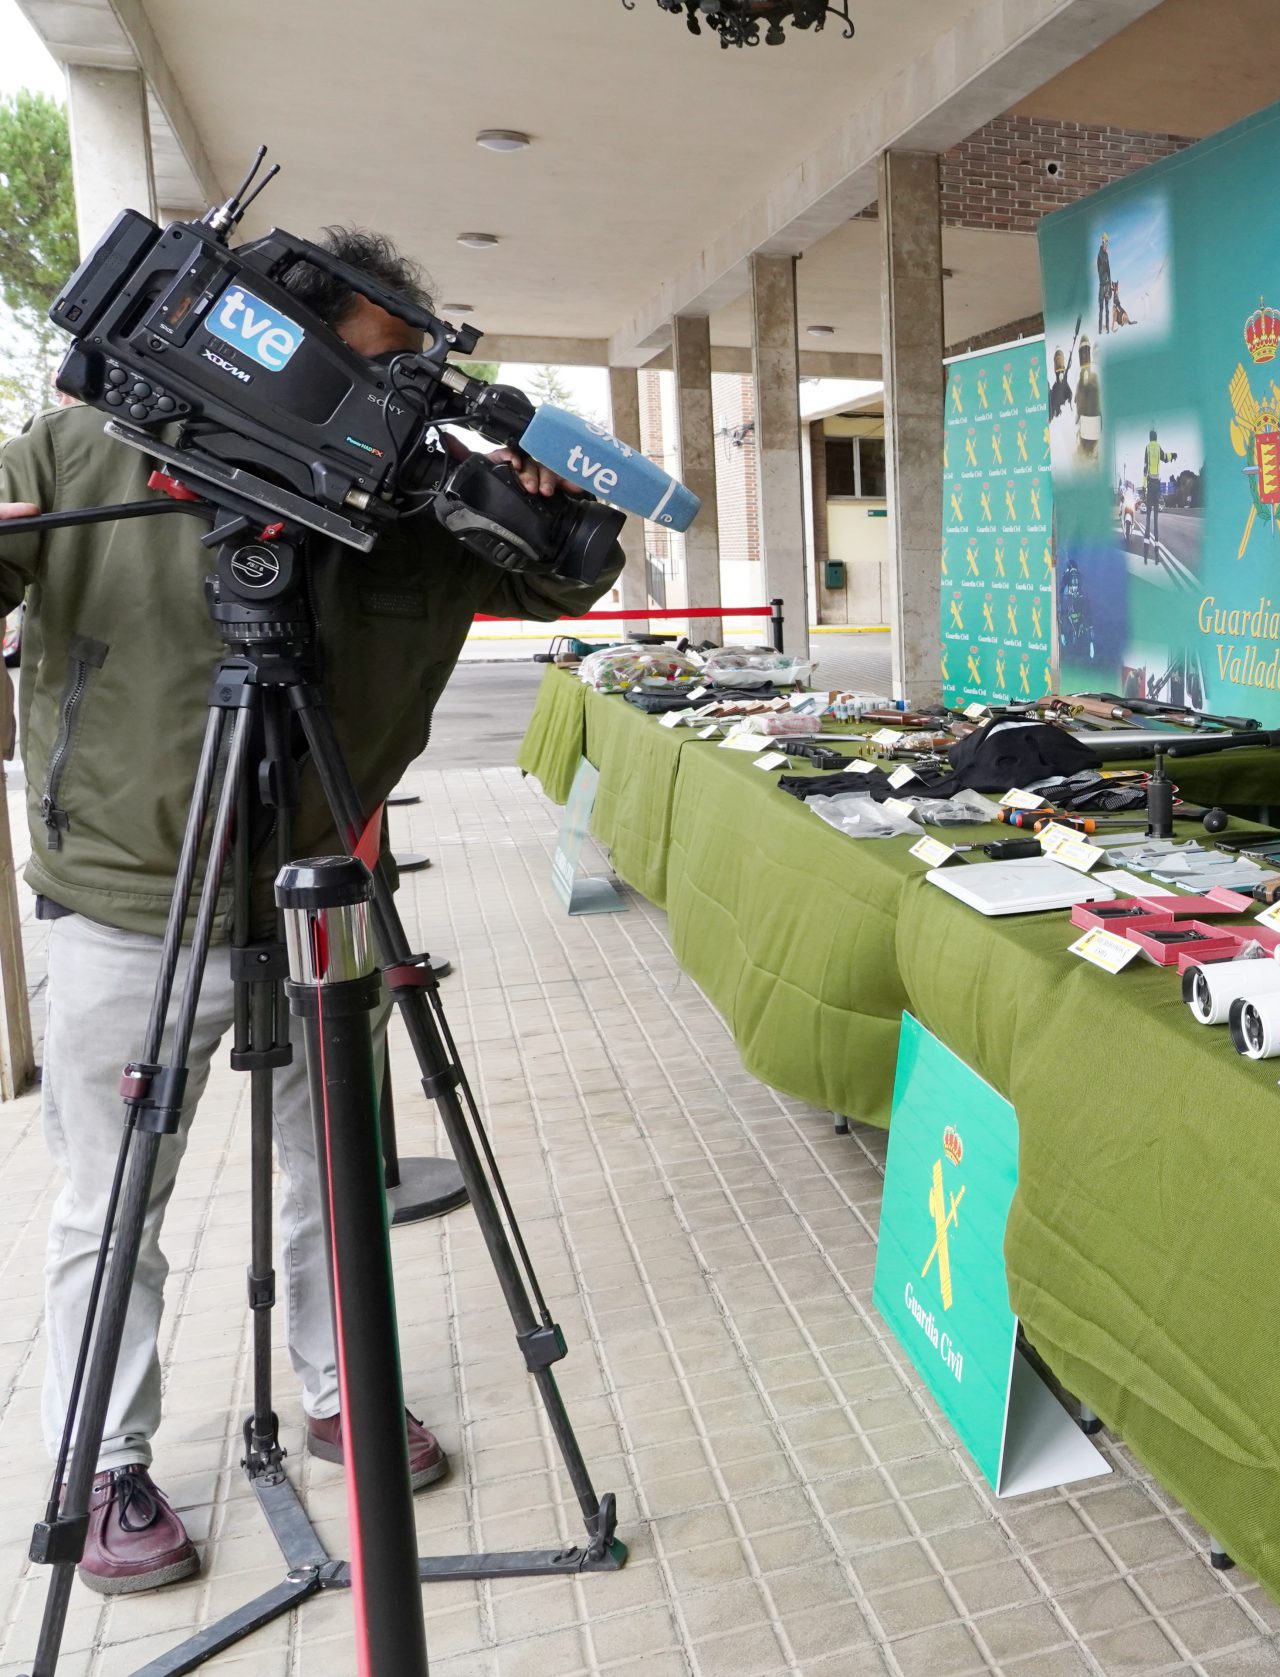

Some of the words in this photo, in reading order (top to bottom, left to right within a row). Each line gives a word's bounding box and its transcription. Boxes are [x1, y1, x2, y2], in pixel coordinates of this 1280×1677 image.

[219, 291, 294, 366] tve
[201, 349, 251, 383] XDCAM
[567, 445, 618, 494] tve
[1198, 596, 1280, 641] Guardia
[905, 1282, 939, 1348] Guardia
[940, 1332, 963, 1382] Civil
